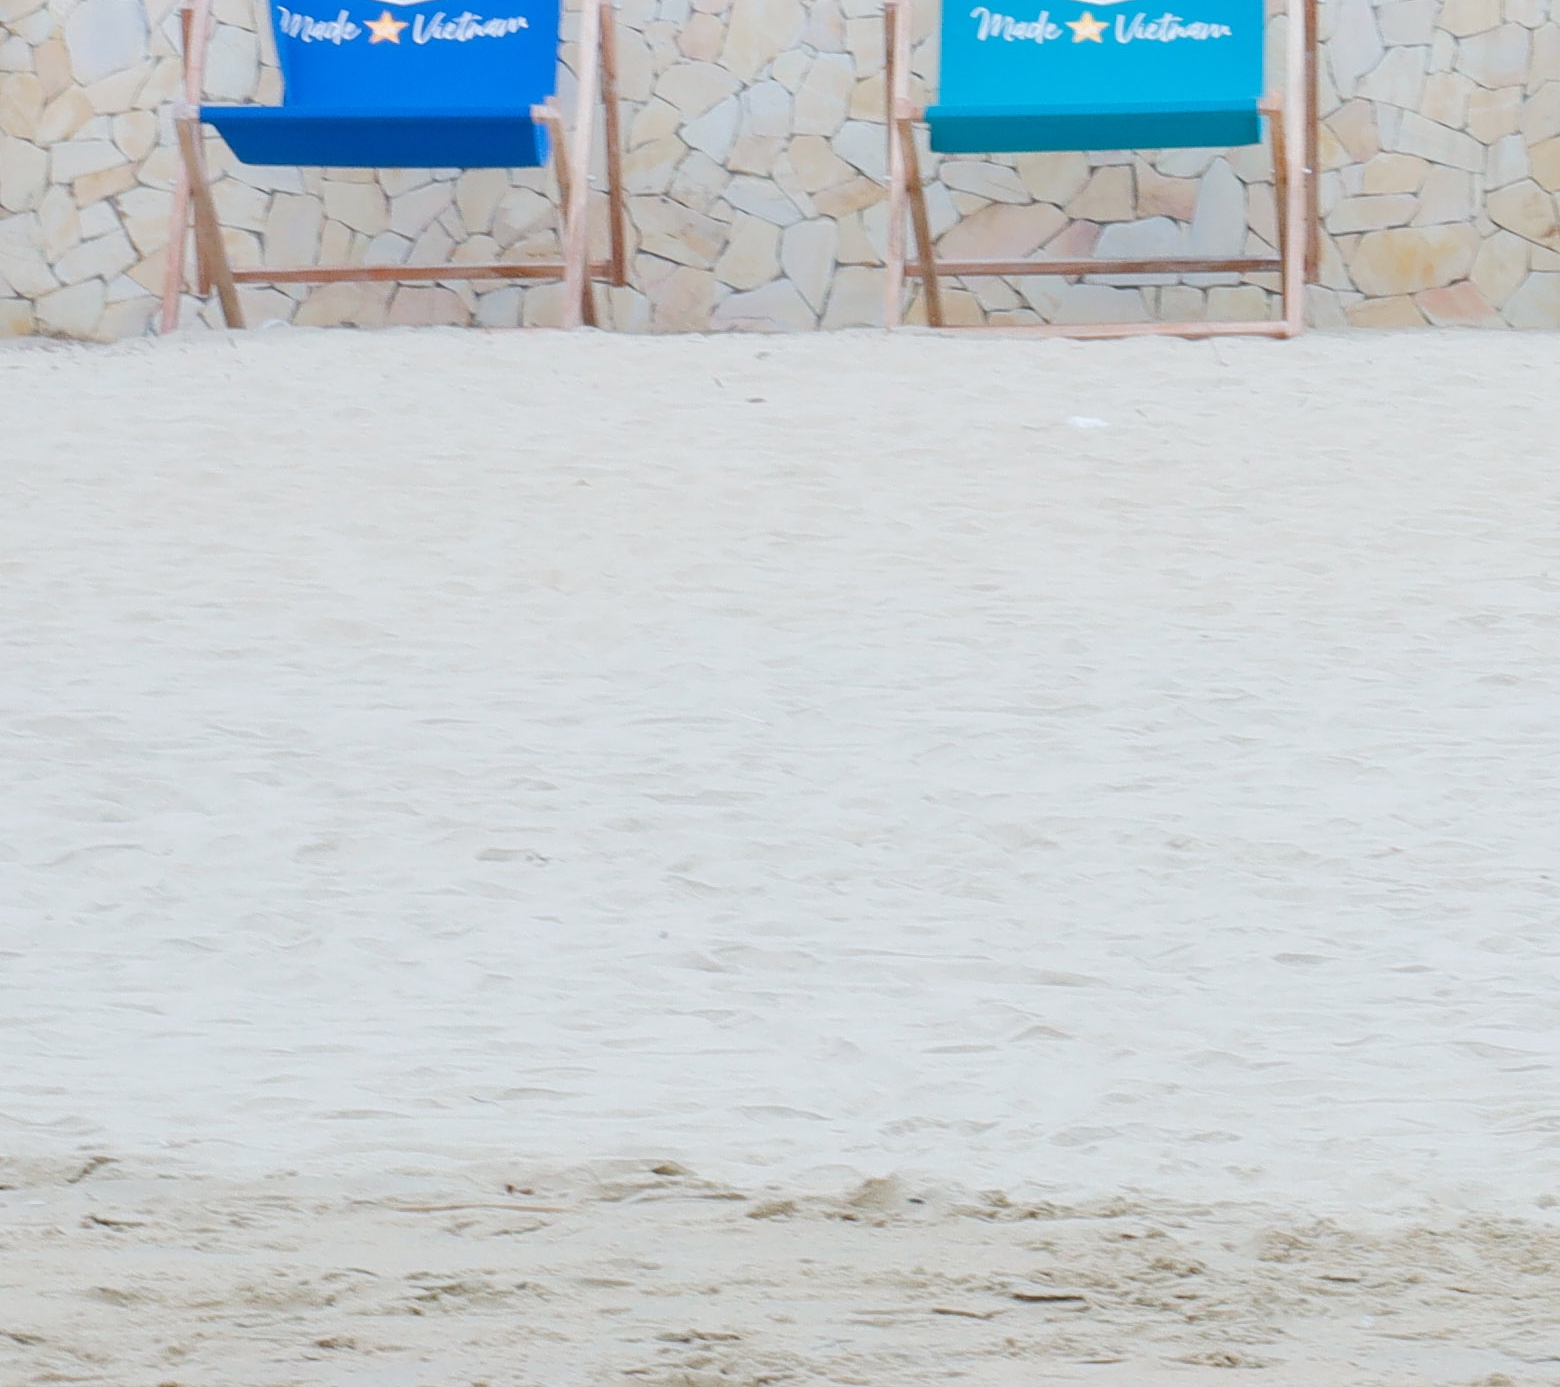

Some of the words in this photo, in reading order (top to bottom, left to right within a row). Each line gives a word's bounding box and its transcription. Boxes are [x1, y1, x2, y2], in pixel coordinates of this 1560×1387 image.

[275, 6, 361, 47] Made
[412, 12, 529, 45] Vietnam
[970, 7, 1063, 44] Made
[1115, 13, 1232, 44] Vietnam
